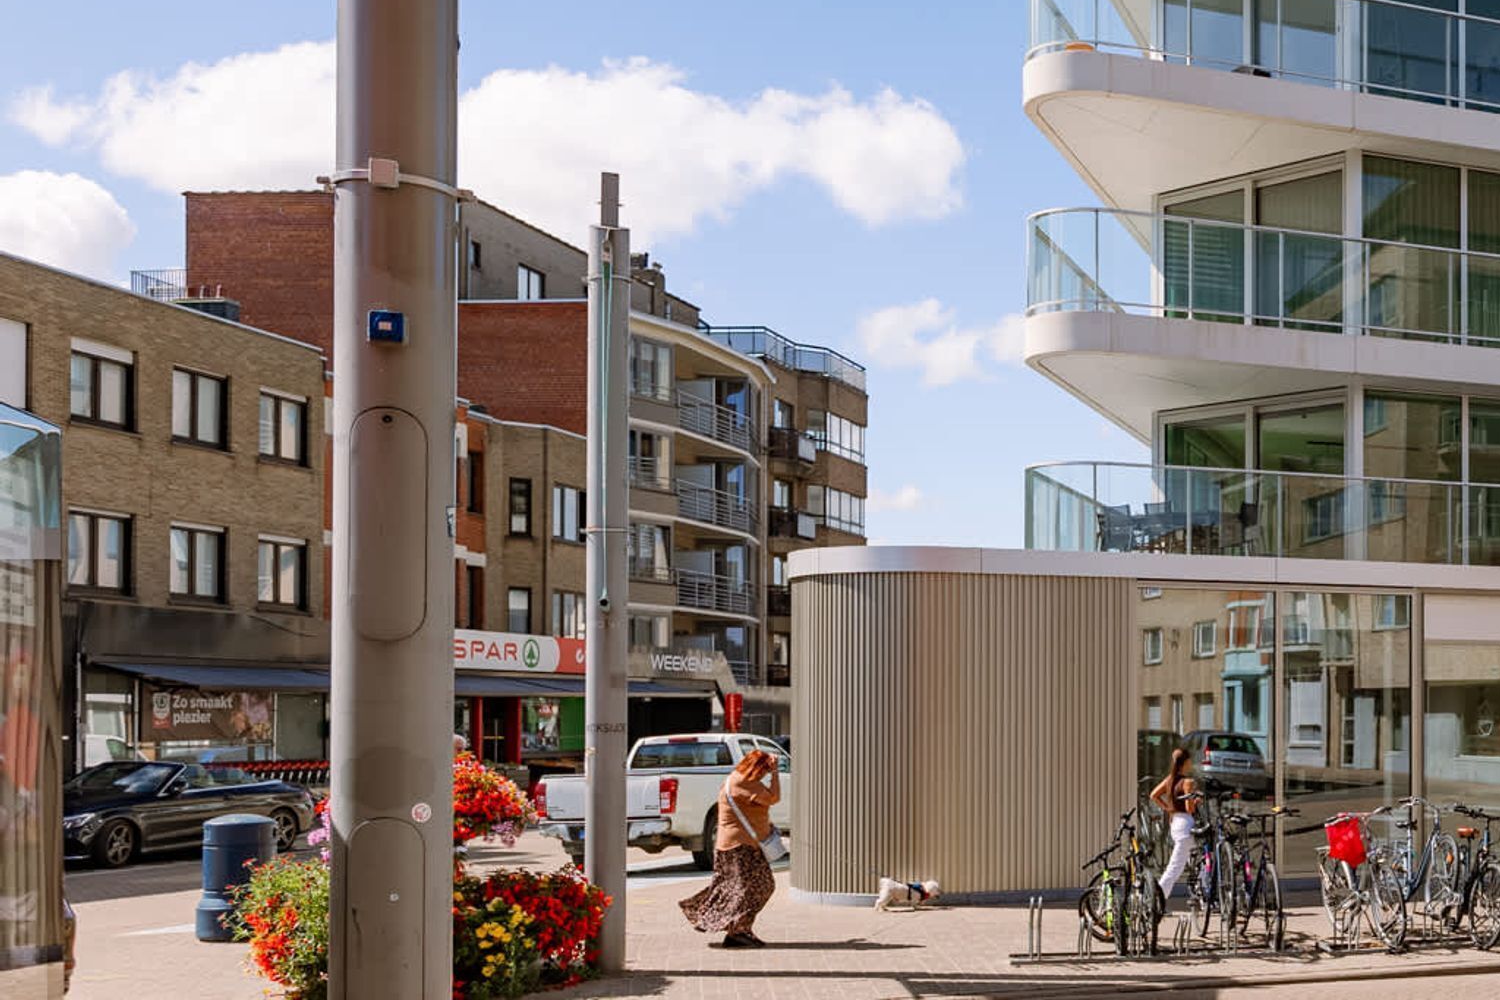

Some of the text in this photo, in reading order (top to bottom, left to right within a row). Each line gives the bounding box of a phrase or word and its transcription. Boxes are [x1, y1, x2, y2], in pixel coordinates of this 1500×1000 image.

[453, 639, 518, 661] SPAR
[650, 654, 713, 672] WEEKEND
[172, 694, 188, 708] Zo
